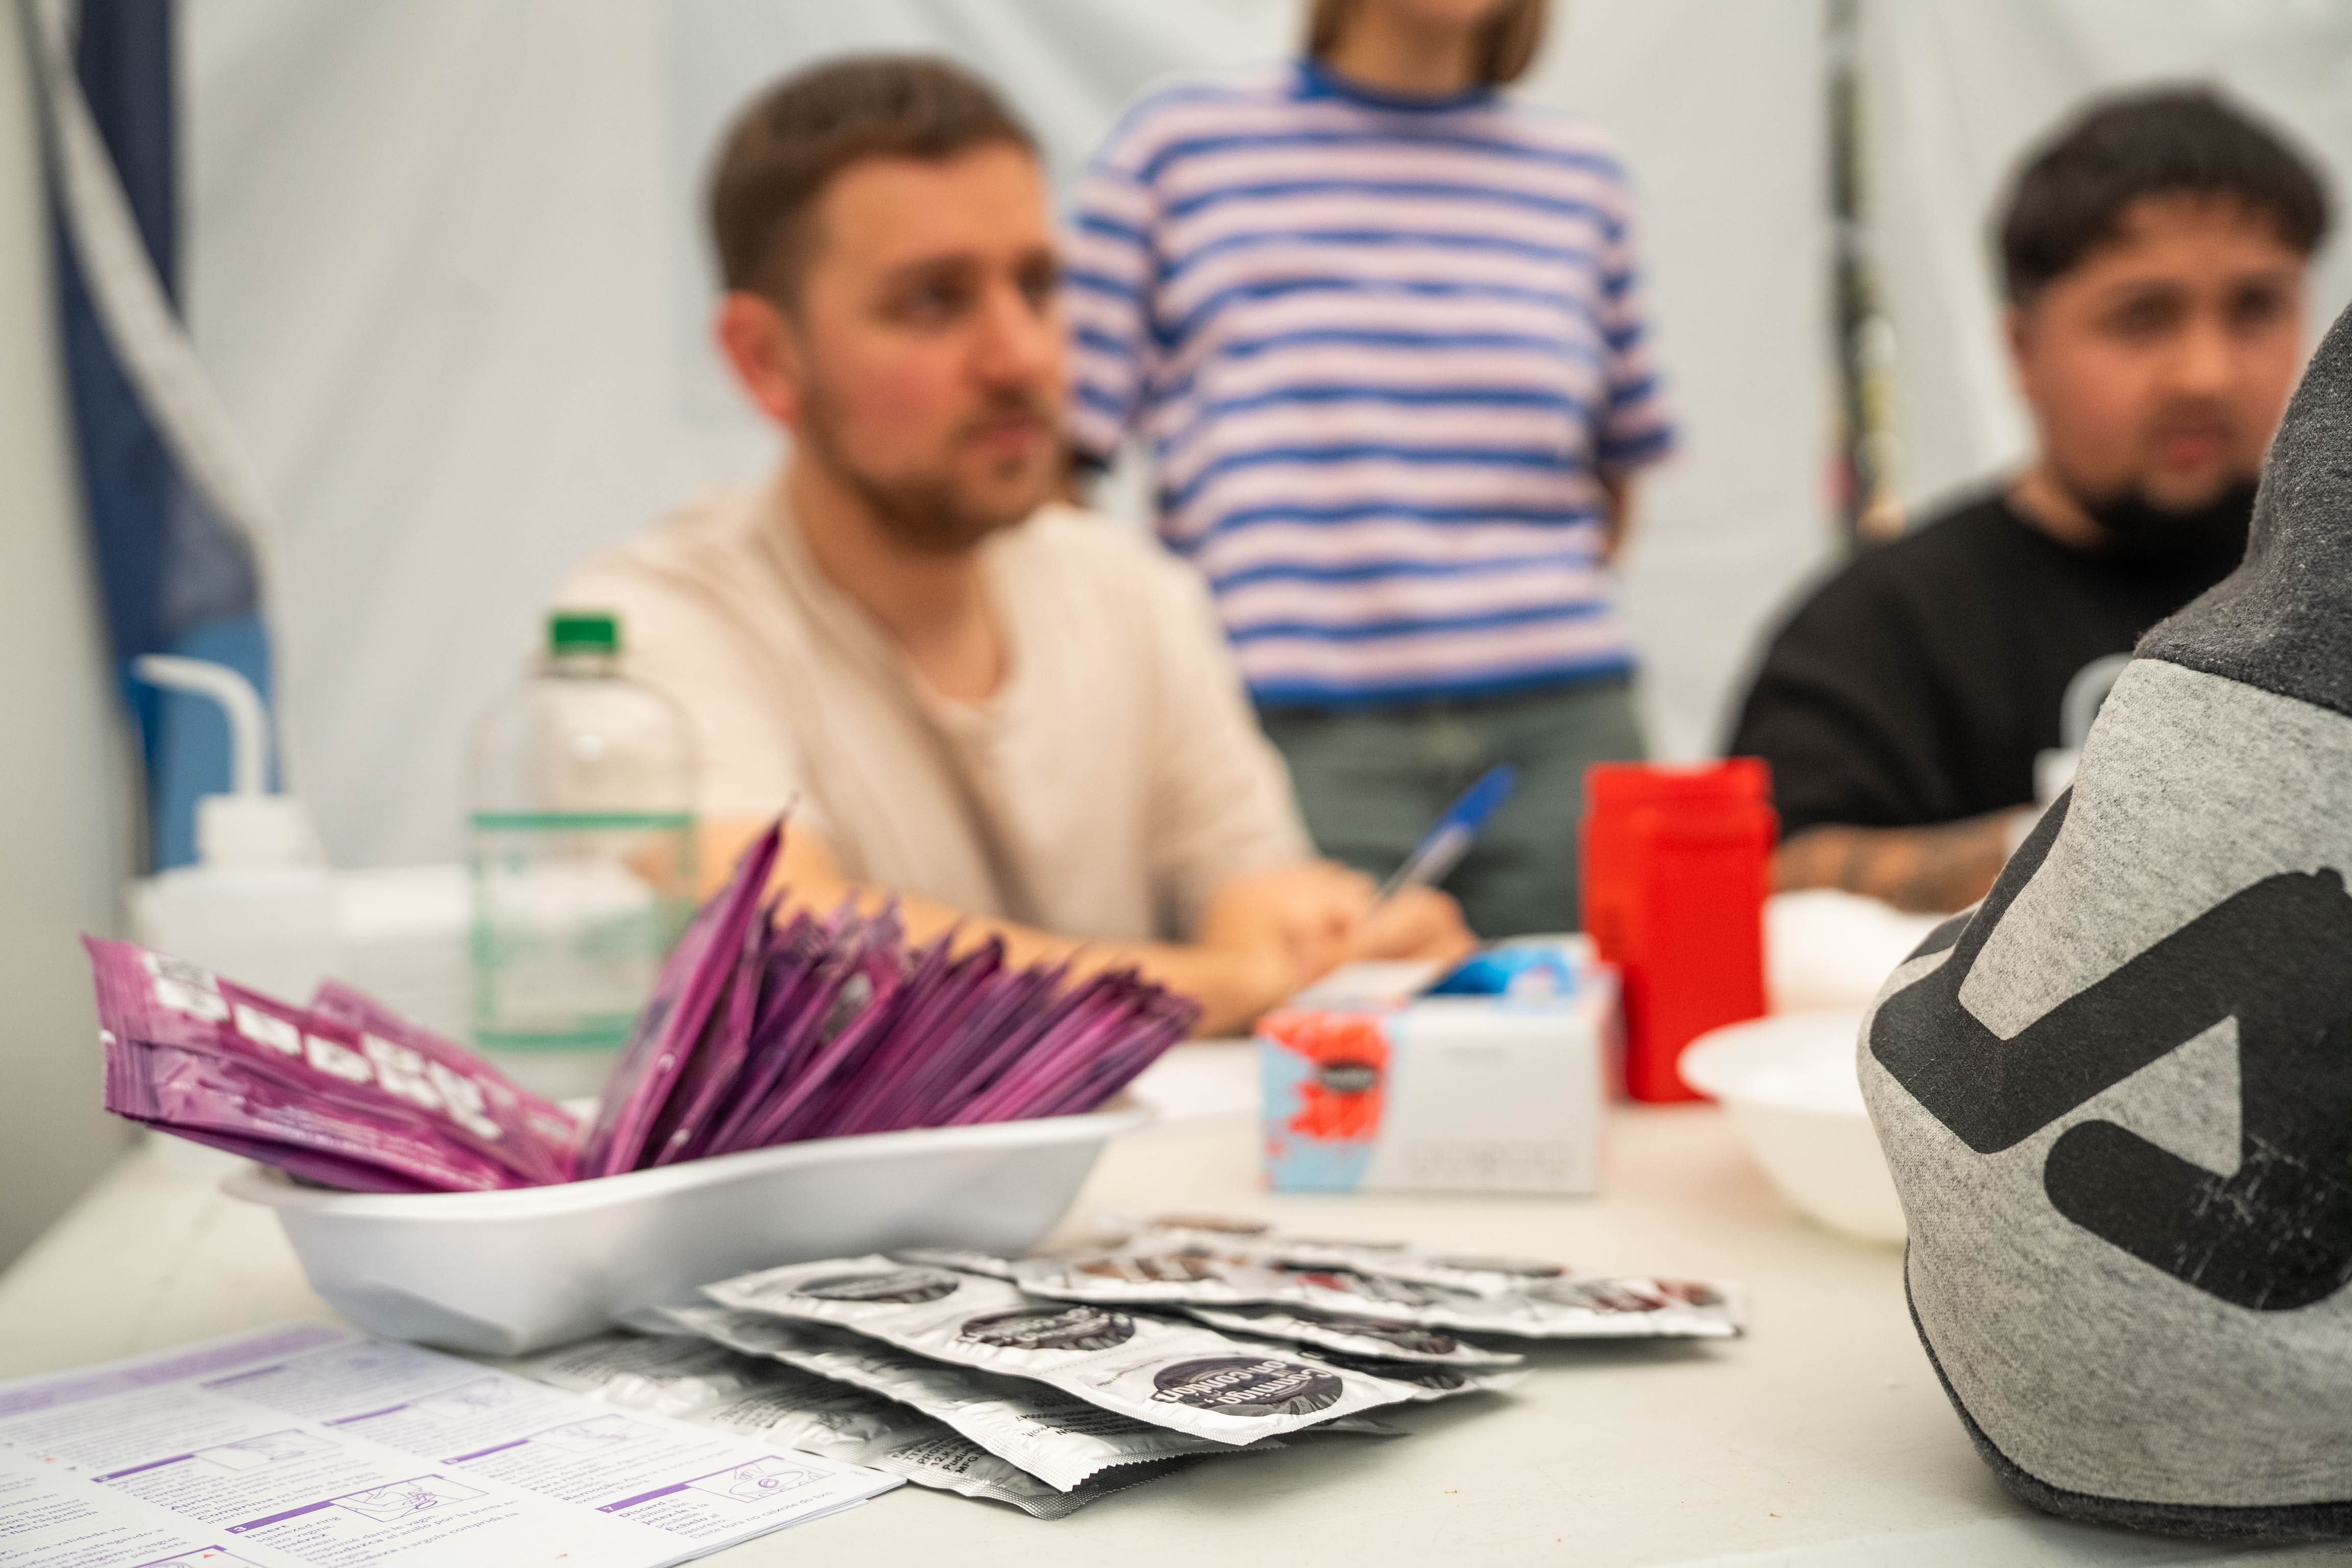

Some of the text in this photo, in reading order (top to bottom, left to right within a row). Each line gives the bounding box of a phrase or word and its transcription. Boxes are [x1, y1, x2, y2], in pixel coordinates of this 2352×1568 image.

[1155, 1371, 1254, 1402] condón
[1204, 1368, 1333, 1404] Conmigo,
[618, 1501, 666, 1517] Discard
[631, 1504, 671, 1522] rubbish
[641, 1508, 690, 1526] Jetez-le
[400, 1523, 432, 1536] anillo
[434, 1515, 454, 1526] por
[470, 1504, 503, 1515] punta
[449, 1515, 503, 1534] comprida
[245, 1524, 289, 1538] Insert
[256, 1516, 341, 1544] squeezed ring
[363, 1530, 389, 1539] dans
[265, 1537, 291, 1547] into
